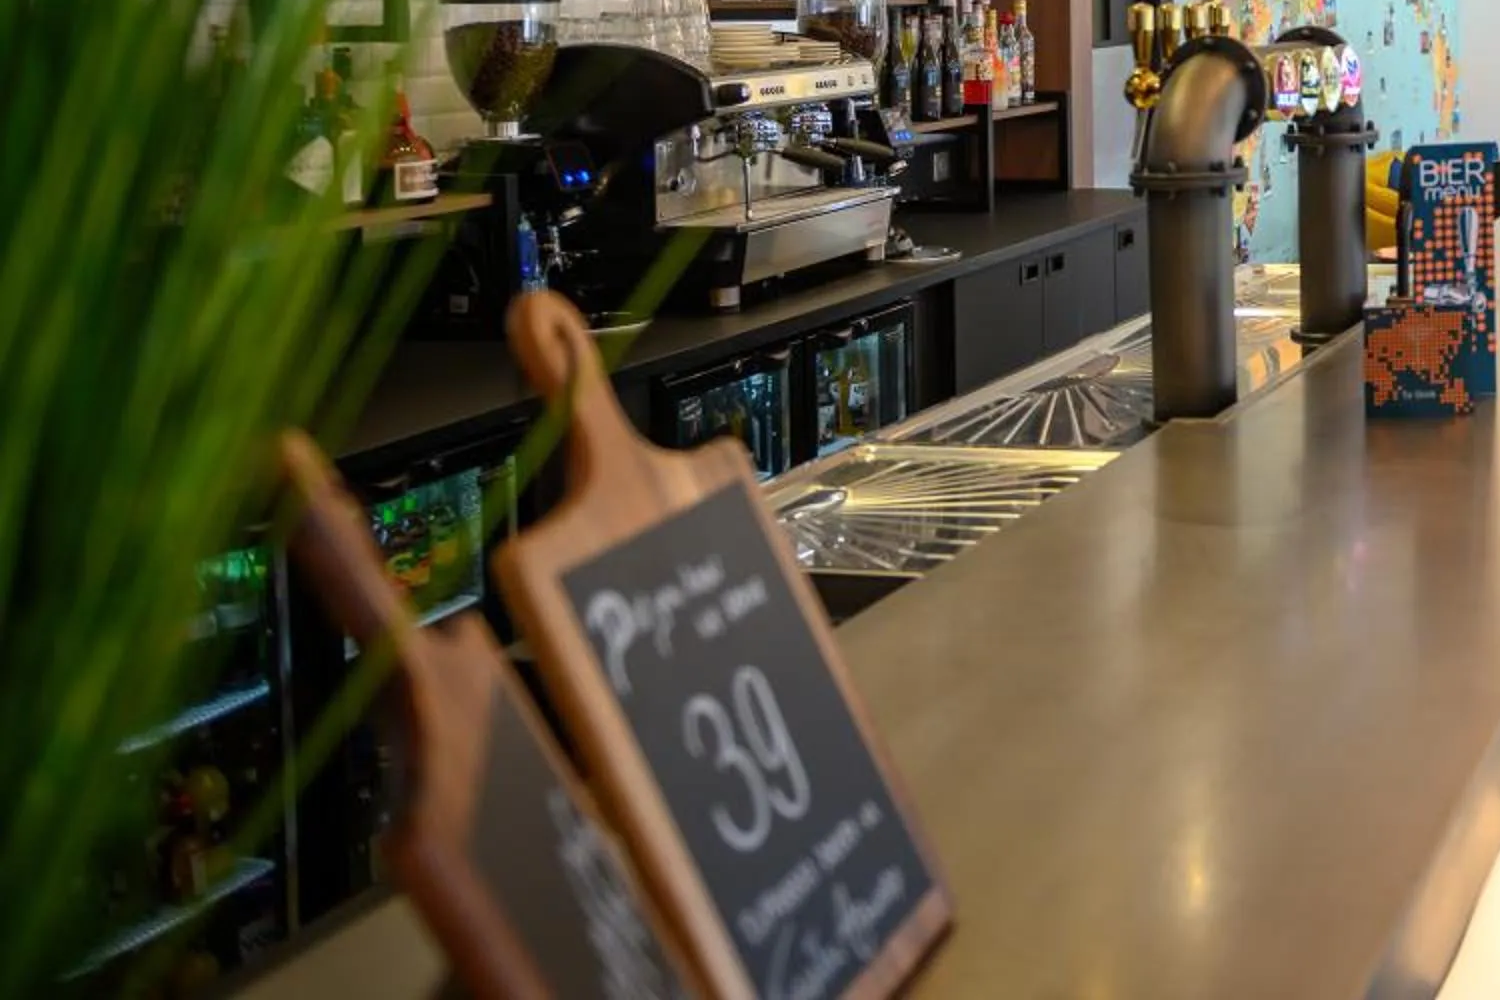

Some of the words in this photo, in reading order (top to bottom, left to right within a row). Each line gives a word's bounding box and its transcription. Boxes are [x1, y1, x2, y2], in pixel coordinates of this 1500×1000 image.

[1420, 158, 1486, 187] BIER
[1424, 184, 1481, 201] menu
[683, 664, 811, 850] 39
